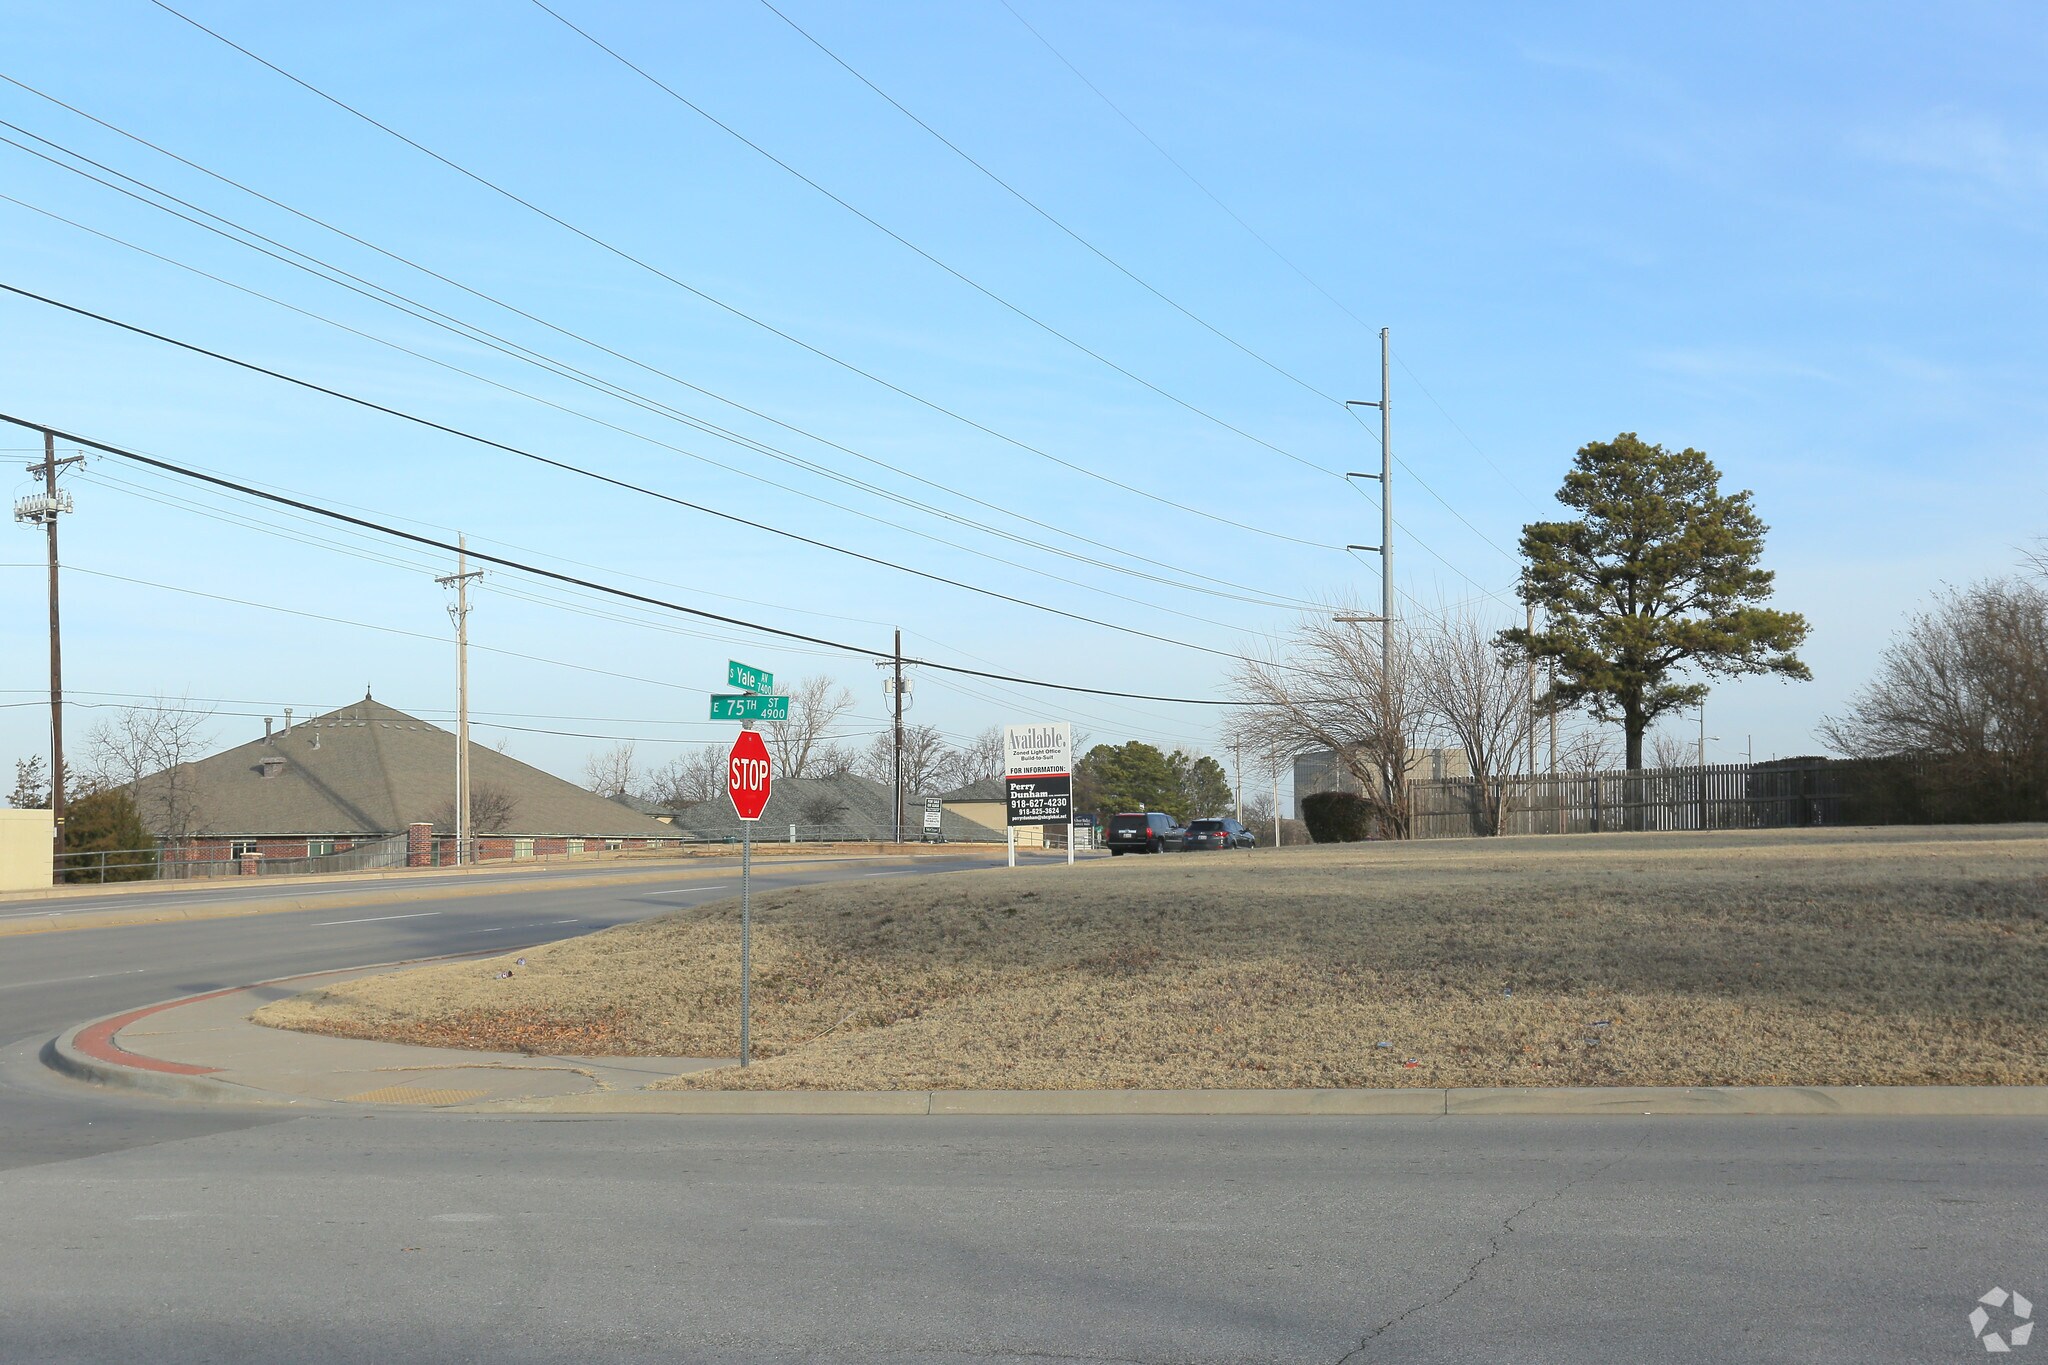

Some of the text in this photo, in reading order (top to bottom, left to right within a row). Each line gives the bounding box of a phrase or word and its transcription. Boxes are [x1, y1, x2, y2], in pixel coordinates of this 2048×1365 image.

[730, 667, 769, 687] S Yale AV
[714, 702, 719, 713] E
[768, 698, 779, 708] ST
[761, 709, 785, 719] 4900
[731, 757, 769, 791] STOP
[1023, 765, 1066, 774] INFORMATION:
[1010, 783, 1035, 791] Perry
[1010, 791, 1048, 799] Dunham
[1011, 798, 1067, 808] 918-627-4230
